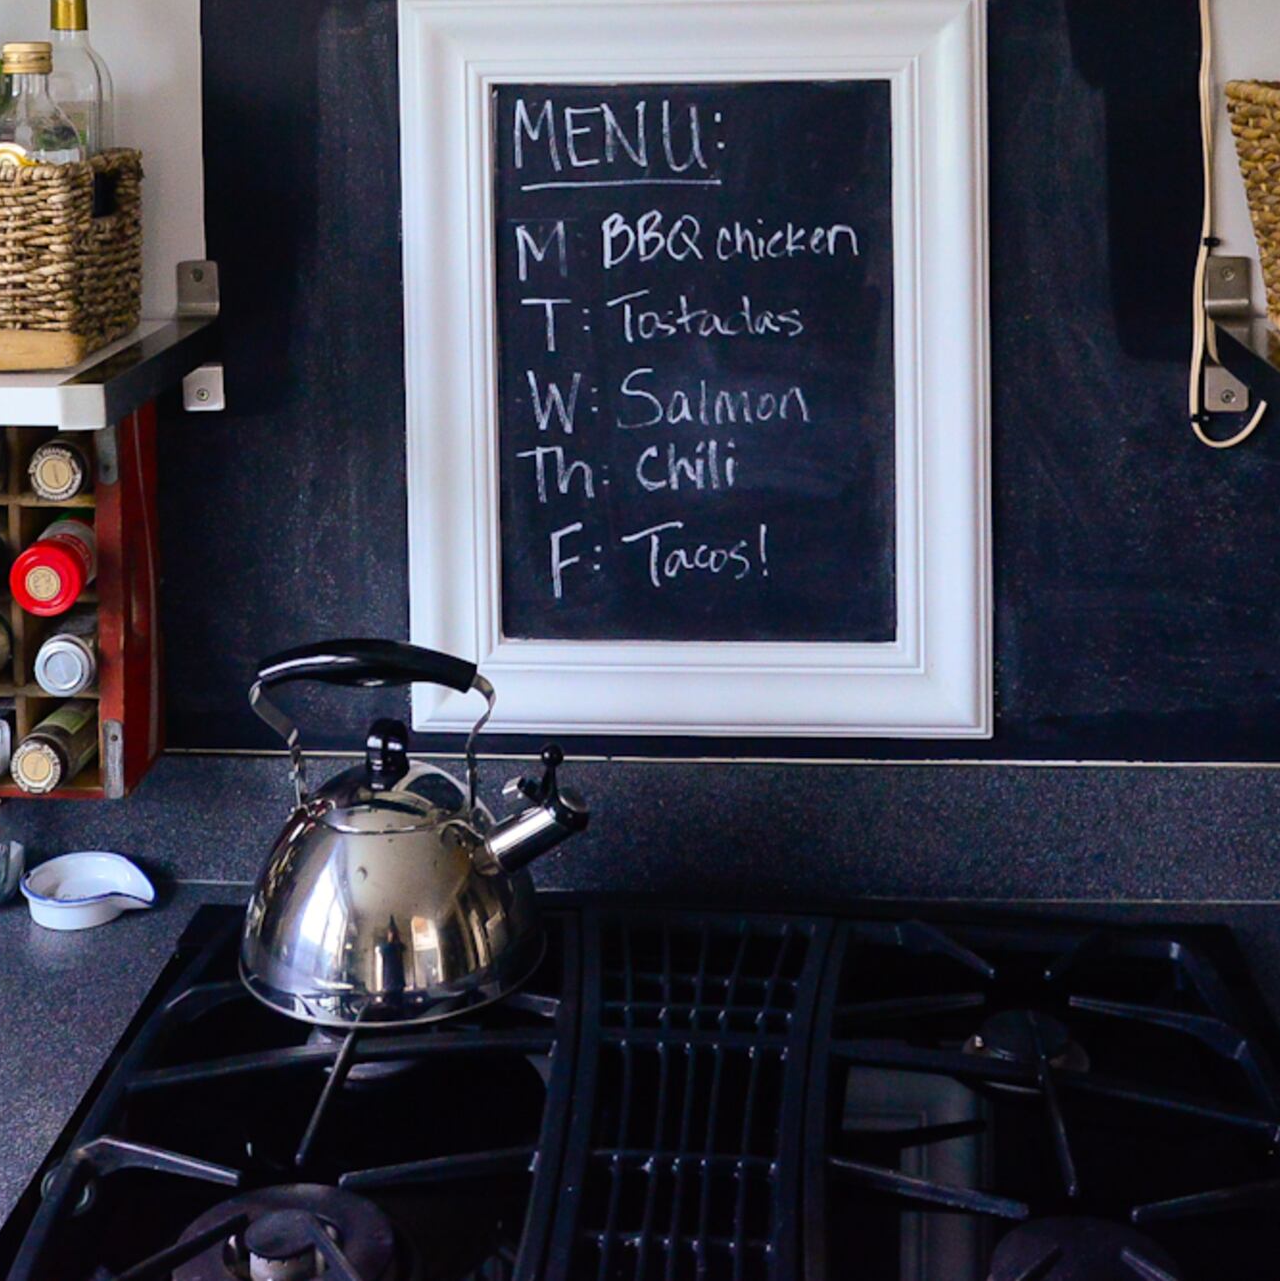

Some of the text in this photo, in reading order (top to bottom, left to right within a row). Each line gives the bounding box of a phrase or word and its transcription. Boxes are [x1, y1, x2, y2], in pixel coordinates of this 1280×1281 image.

[515, 99, 726, 172] MENU:
[602, 209, 703, 269] BBQ
[716, 221, 860, 261] chicken
[522, 290, 805, 352] T: Tostadas
[527, 368, 810, 434] W: Salmon
[516, 446, 610, 503] Th:
[550, 521, 770, 598] F: Tacos!
